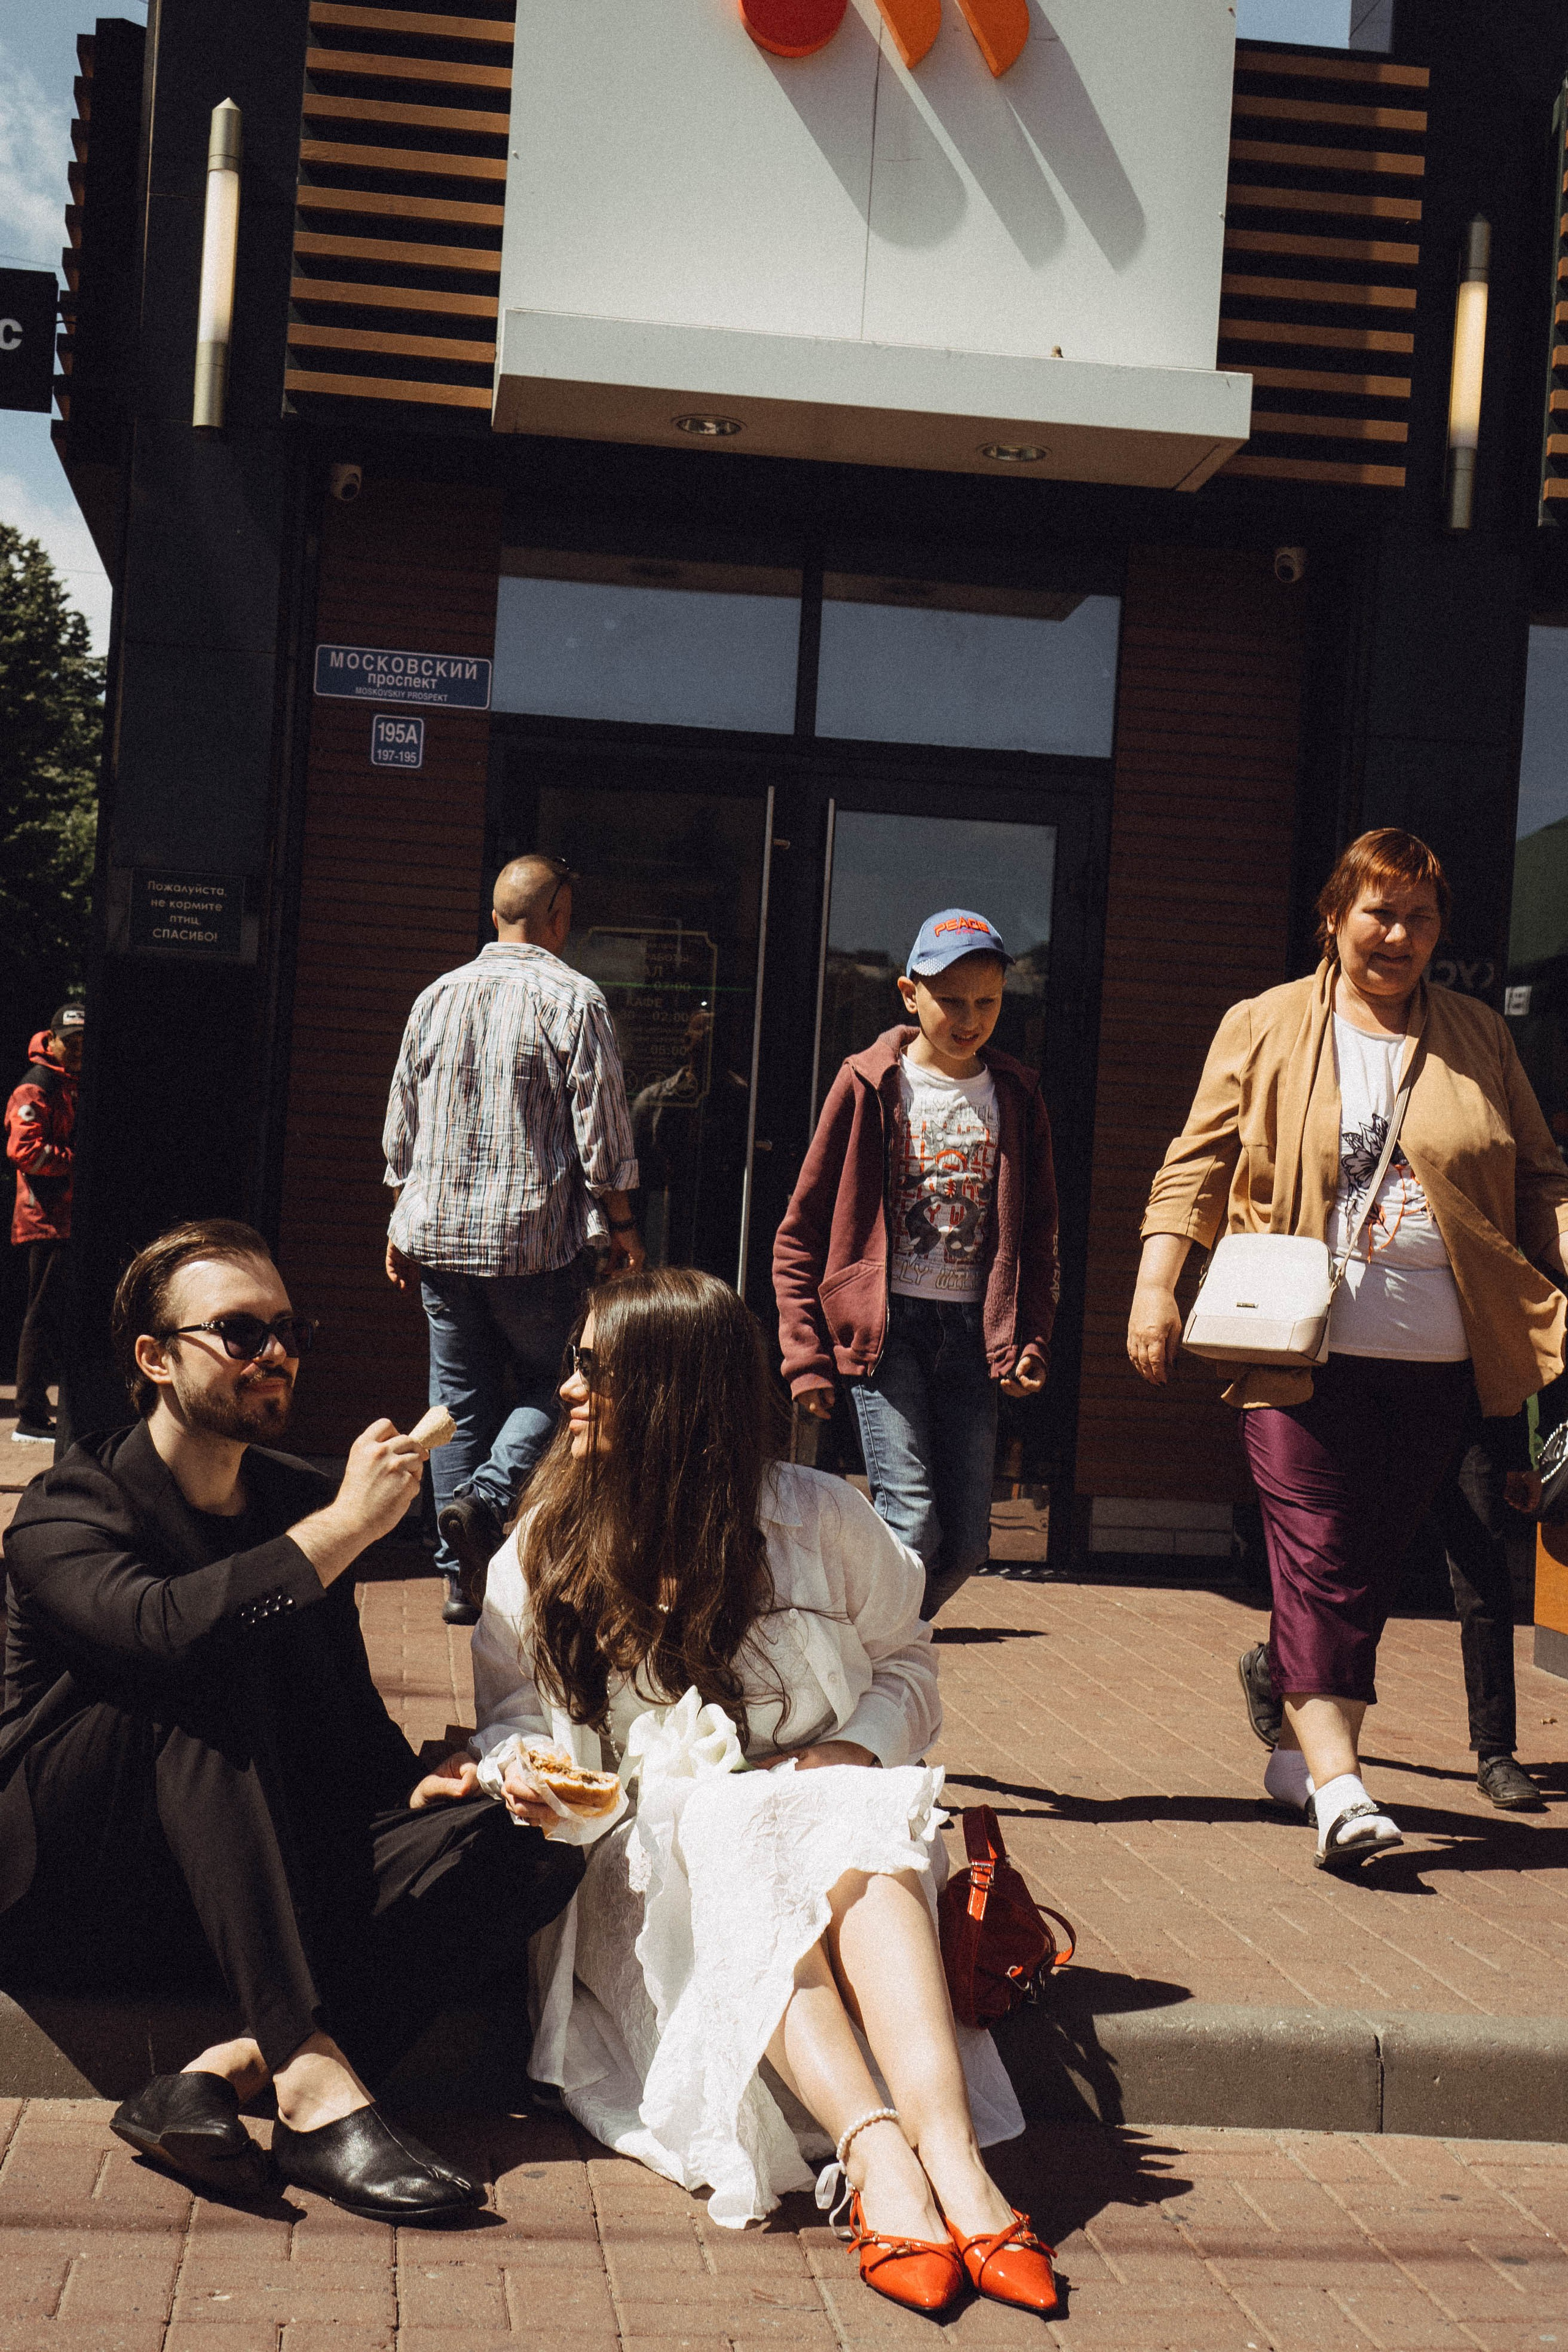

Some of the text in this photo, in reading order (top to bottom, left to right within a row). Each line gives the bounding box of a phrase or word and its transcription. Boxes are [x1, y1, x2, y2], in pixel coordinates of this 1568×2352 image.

[330, 650, 478, 680] МОСКОВСКИЙ
[367, 673, 439, 690] проспект
[355, 687, 448, 702] MOSKOVSKIY PROSPEKT
[377, 722, 418, 744] 195А
[376, 748, 417, 763] 197-195
[148, 881, 227, 897] Пожалуйста,
[151, 899, 224, 912] не кормите
[153, 928, 218, 943] СПАСИБО!
